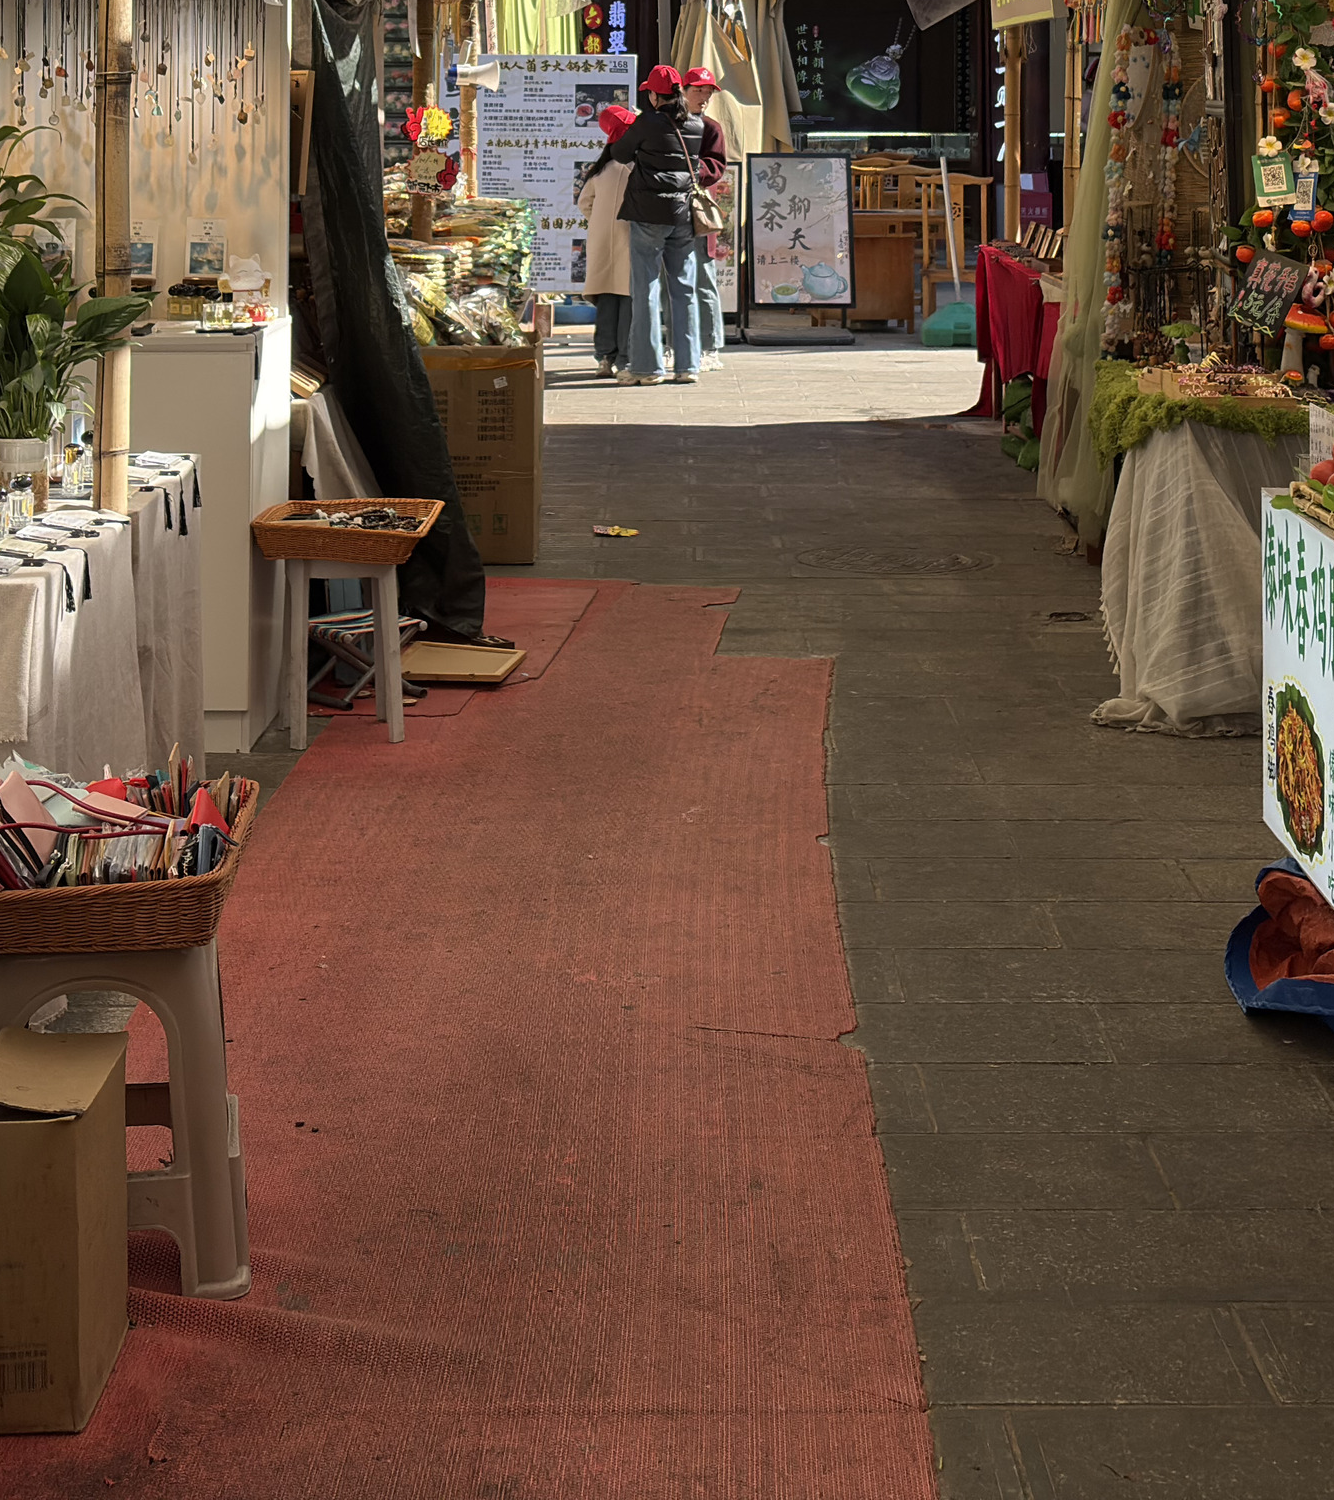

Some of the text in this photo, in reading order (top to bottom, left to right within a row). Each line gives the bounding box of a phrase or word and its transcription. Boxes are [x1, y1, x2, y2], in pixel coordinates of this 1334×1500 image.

[608, 1, 627, 55] 翡翠
[755, 161, 787, 232] 喝茶
[787, 194, 812, 250] 聊天
[756, 254, 801, 266] 请上二楼
